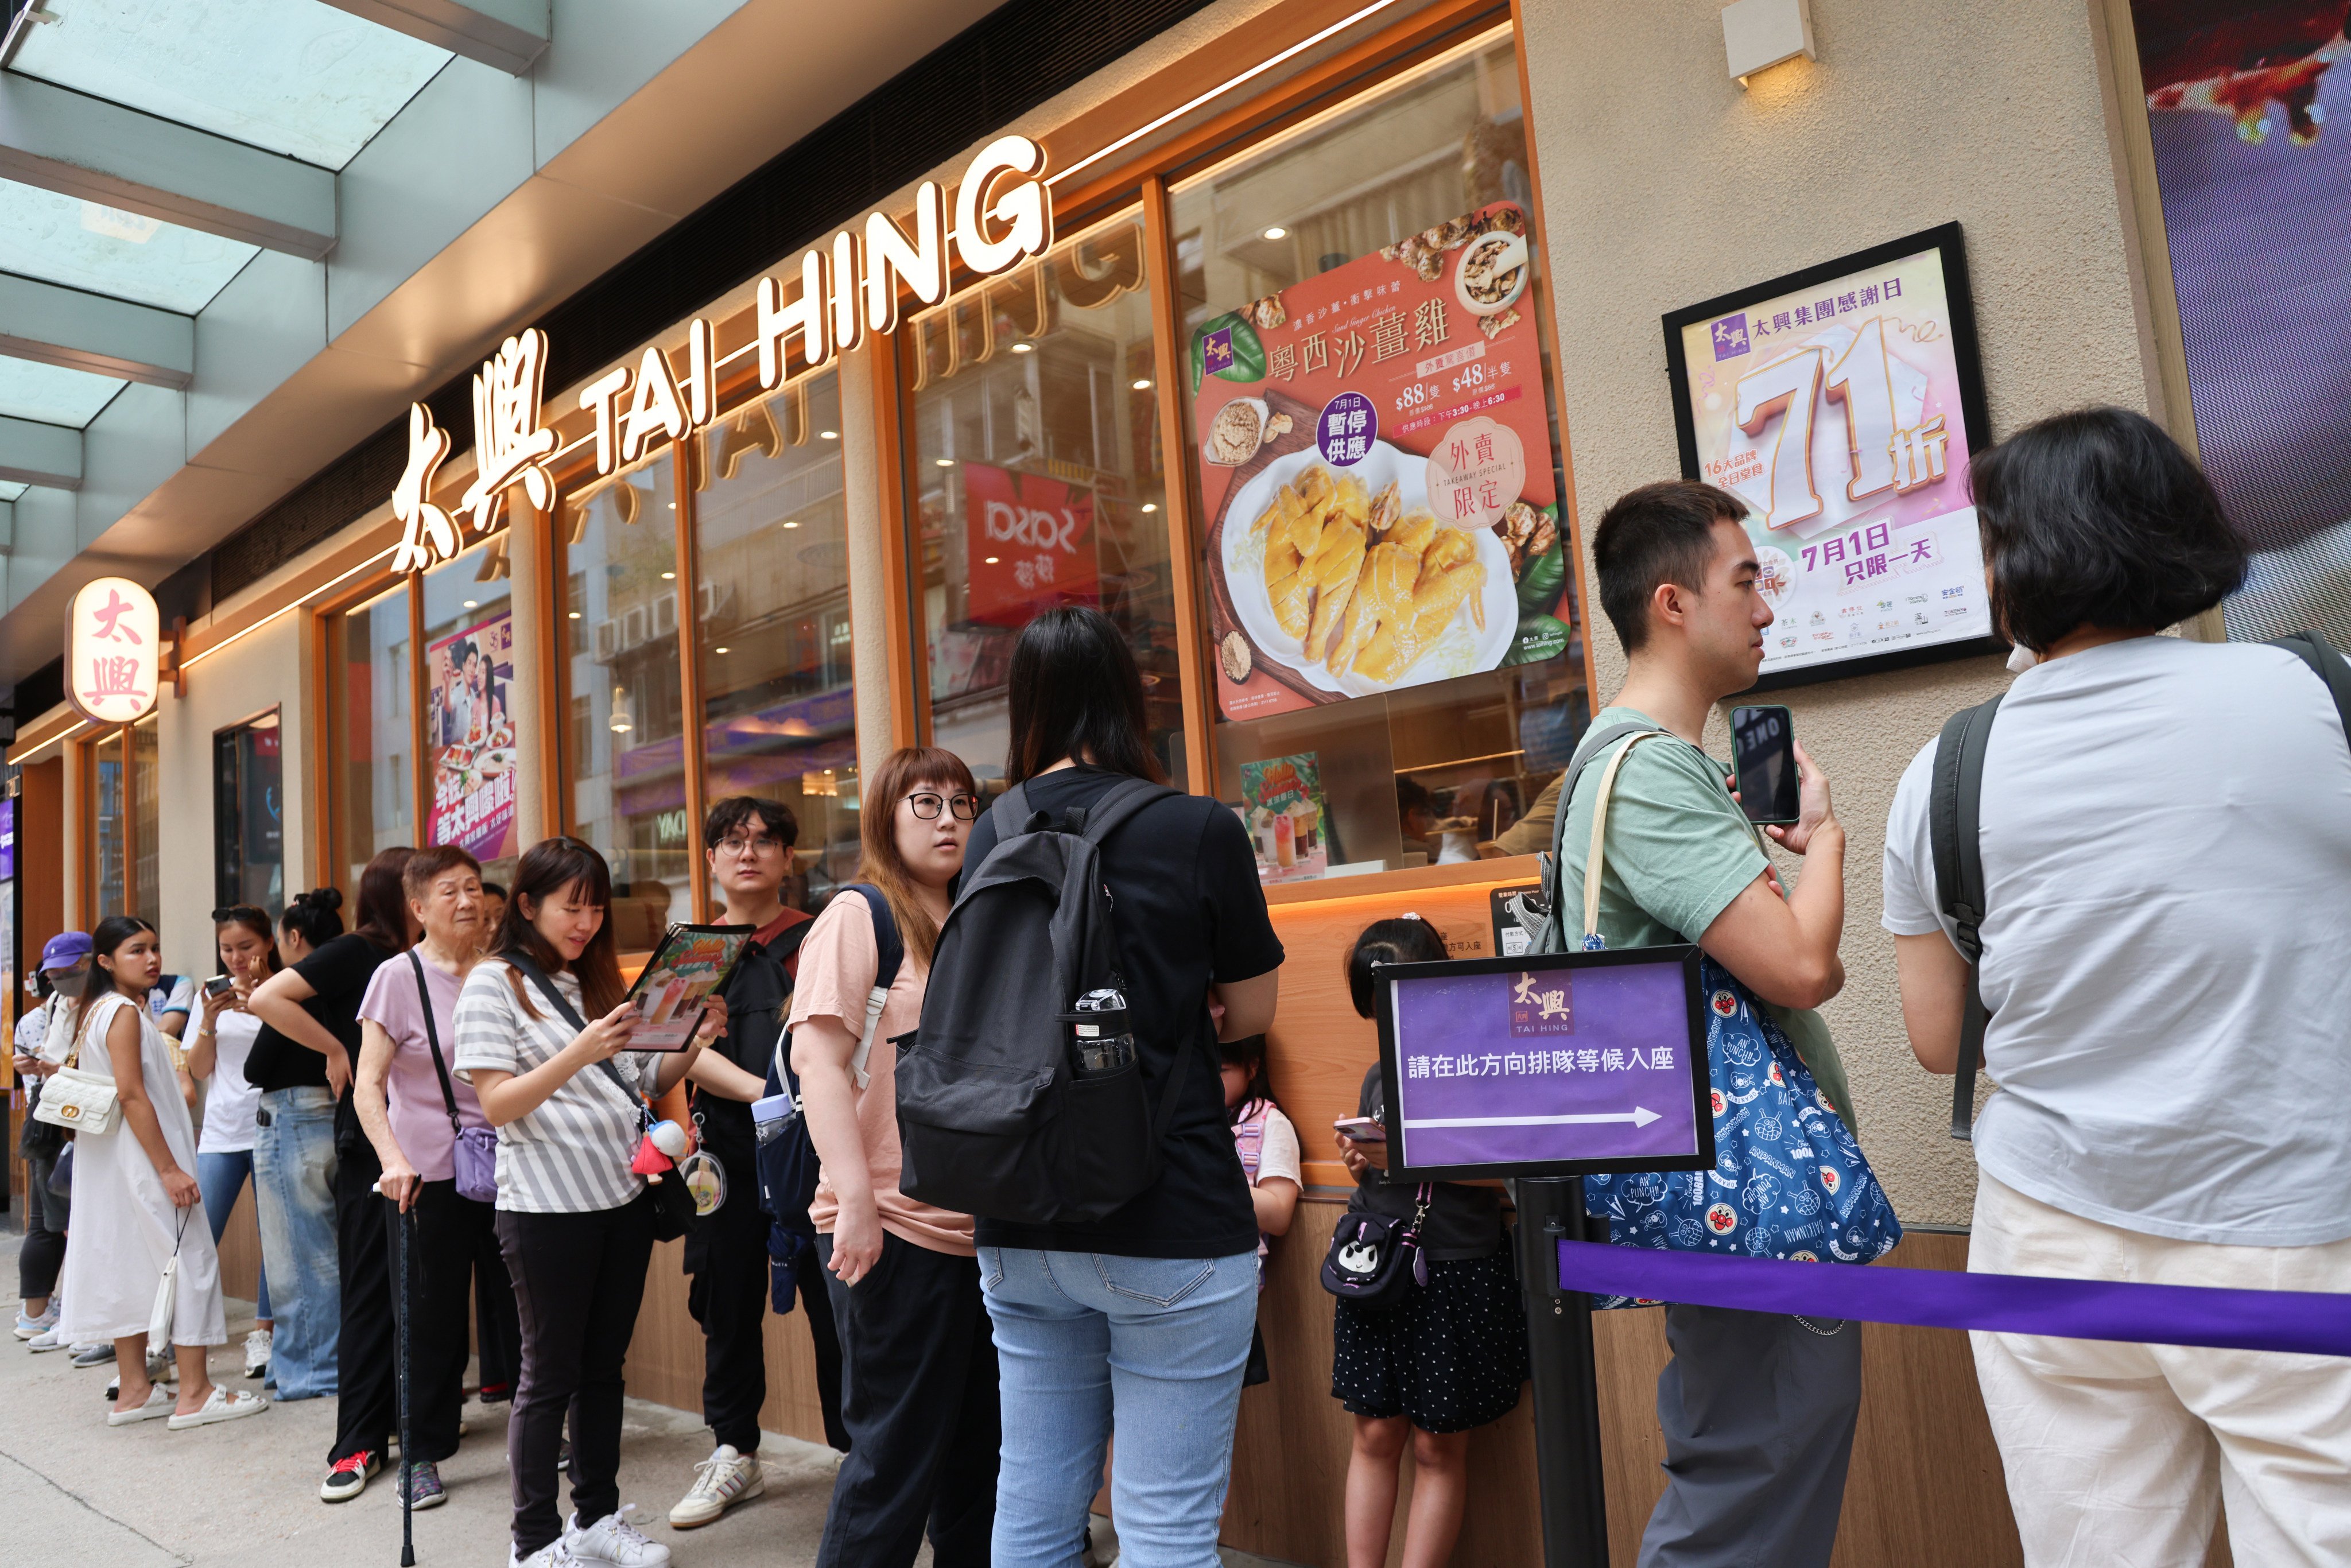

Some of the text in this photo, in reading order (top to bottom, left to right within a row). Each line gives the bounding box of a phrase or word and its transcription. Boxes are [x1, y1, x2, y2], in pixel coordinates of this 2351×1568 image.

[1332, 304, 1396, 334] Sand Ginger Chicken
[1752, 277, 1902, 340] 太興集團感謝日
[1715, 323, 1747, 348] 太興
[391, 328, 561, 573] 太興
[579, 317, 716, 475] TAI
[757, 135, 1054, 391] HING
[1334, 397, 1360, 410] 7月1日
[1328, 409, 1367, 437] 暫停
[1326, 436, 1366, 463] 供應
[1450, 432, 1495, 472] 外賣
[1704, 449, 1758, 478] 16大品牌
[1444, 463, 1506, 487] TAKEAWAY SPECIAL
[1718, 462, 1763, 490] 全日堂食
[1454, 480, 1501, 520] 限定
[1801, 522, 1891, 573] 7月1日
[1844, 537, 1933, 586] 只限一天
[83, 589, 148, 712] 太興
[1523, 638, 1565, 650] www.taihing.com
[1514, 971, 1570, 1020] 太興
[1727, 1042, 1753, 1062] PUNCH!!
[1737, 1038, 1748, 1049] AN
[1407, 1046, 1675, 1079] 請在此方向排隊等候入座
[1714, 1107, 1750, 1143] ANPANMAN
[1749, 1146, 1796, 1179] ANPANMAN
[1630, 1186, 1659, 1198] PUNCH!!
[1640, 1175, 1649, 1187] AN
[1840, 1173, 1868, 1218] ANPANMAN
[1784, 1219, 1825, 1244] BAIKINMAN
